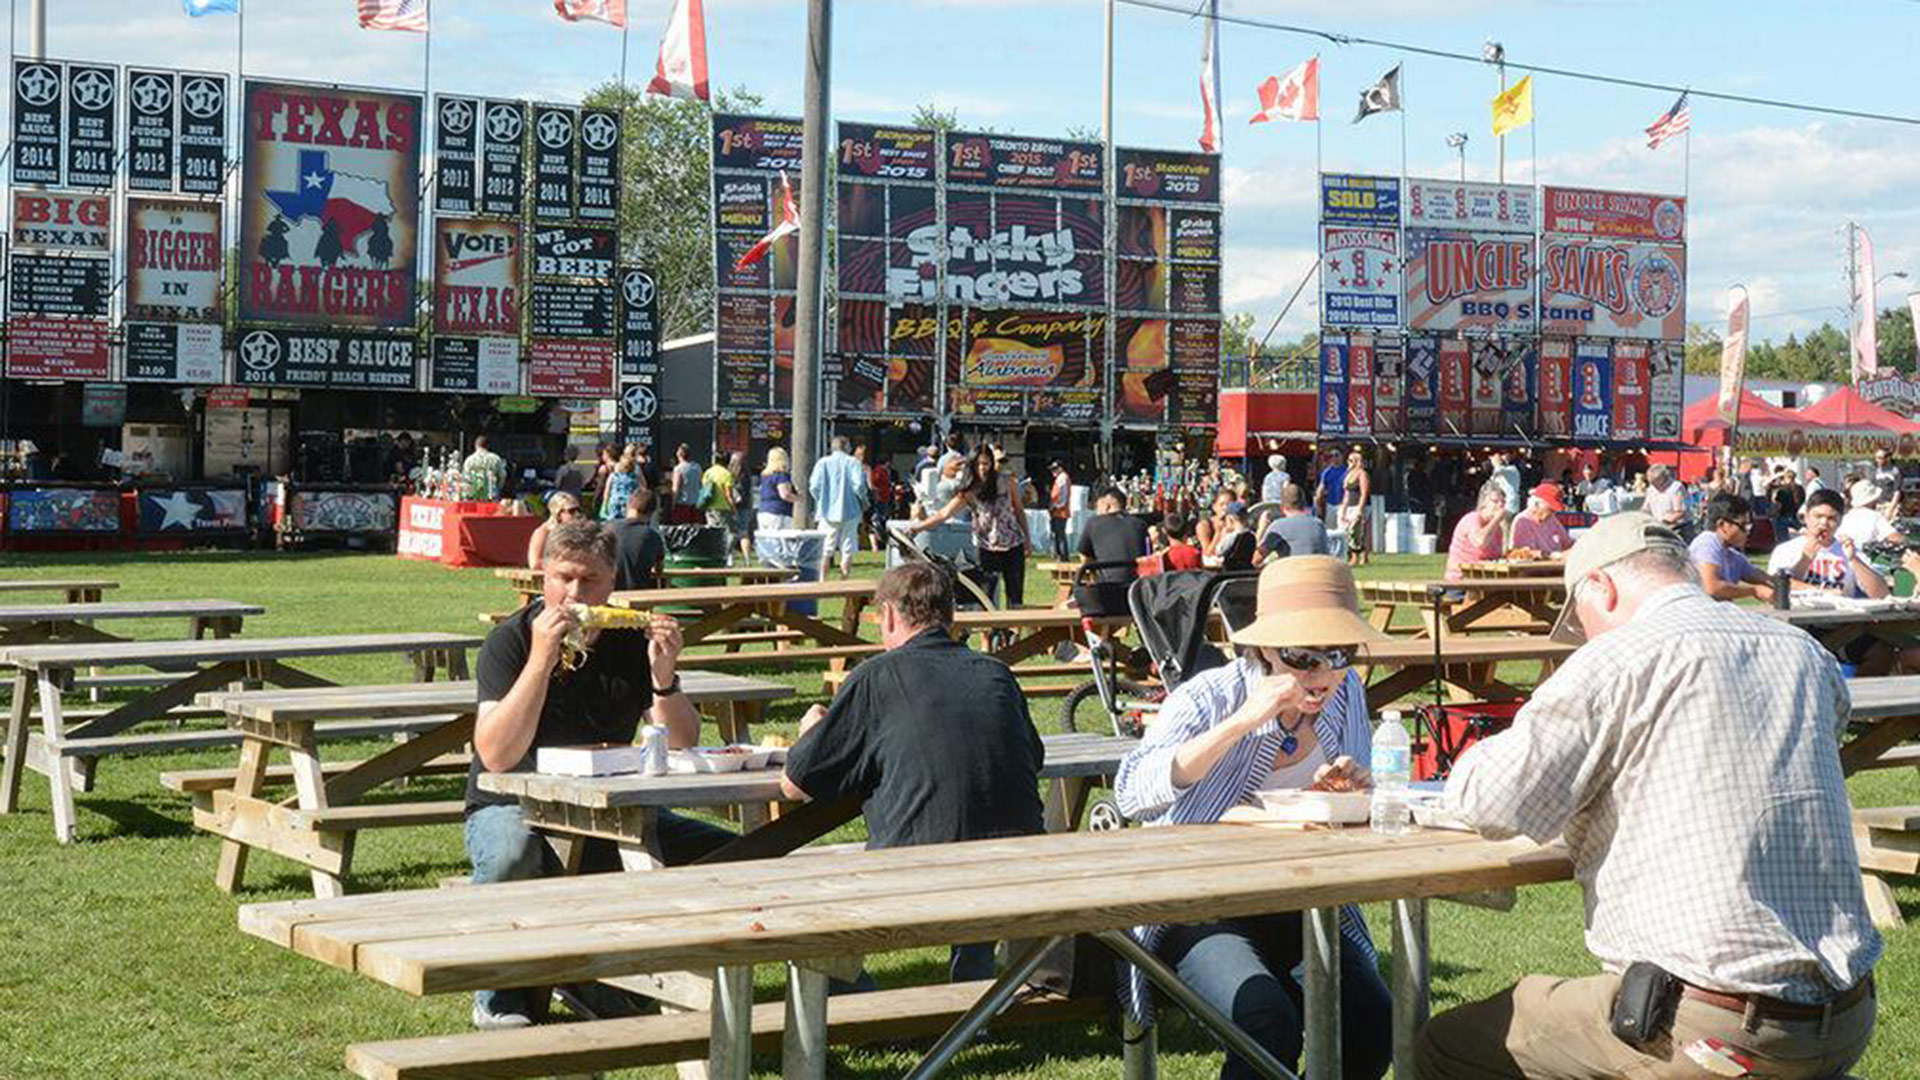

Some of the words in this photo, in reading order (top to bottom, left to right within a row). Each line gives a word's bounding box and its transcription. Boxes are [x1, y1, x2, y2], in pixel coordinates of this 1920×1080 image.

[24, 113, 52, 122] BEST
[78, 117, 105, 128] BEST
[138, 116, 164, 126] BEST
[253, 91, 416, 152] TEXAS
[20, 123, 56, 134] SAUCE
[78, 128, 104, 138] RIBS
[189, 125, 215, 135] BEST
[182, 134, 224, 146] CHICKEN
[444, 136, 467, 147] BEST
[718, 129, 753, 156] 1st
[20, 146, 54, 166] 2014
[543, 154, 566, 164] BEST
[840, 138, 872, 164] 1st
[951, 142, 982, 167] 1st
[989, 140, 1030, 152] TORONTO
[1068, 150, 1098, 174] 1st
[74, 150, 107, 171] 2014
[135, 152, 166, 172] 2012
[186, 158, 218, 178] 2014
[540, 164, 569, 174] SAUCE
[587, 157, 610, 167] BEST
[442, 168, 470, 188] 2011
[876, 165, 928, 178] 2015
[1123, 163, 1152, 188] 1st
[487, 178, 514, 196] 2012
[540, 184, 568, 202] 2014
[584, 186, 610, 206] 2014
[1164, 180, 1200, 194] 2013
[1554, 192, 1604, 212] UNCLE
[17, 196, 110, 228] BIG
[169, 216, 182, 225] IS
[720, 212, 762, 226] MENU
[14, 228, 108, 246] TEXAN
[534, 230, 566, 244] WE
[906, 224, 1074, 266] Sticky
[1326, 231, 1394, 251] MISSISSAUGA
[135, 228, 216, 272] BIGGER
[552, 238, 594, 255] GOT
[1176, 248, 1213, 258] MENU
[536, 256, 613, 278] BEEF
[1428, 239, 1527, 304] UNCLE
[1546, 243, 1629, 315] SAM'S
[161, 282, 188, 296] IN
[250, 261, 406, 319] RANGERS
[888, 268, 1084, 310] Fingers
[442, 286, 516, 325] TEXAS
[1330, 295, 1352, 307] 2013
[1353, 297, 1371, 308] Best
[135, 304, 216, 320] TEXAS
[1328, 310, 1350, 322] 2014
[1351, 312, 1370, 323] Best
[1372, 313, 1396, 324] Sauce
[1461, 302, 1510, 318] BBQ
[1518, 304, 1594, 320] Stand
[891, 319, 964, 340] BBQ
[970, 320, 988, 336] &
[996, 316, 1108, 340] Company
[288, 337, 339, 364] BEST
[348, 340, 412, 366] SAUCE
[244, 370, 276, 383] 2014
[286, 369, 328, 382] FREDDY
[332, 370, 366, 383] BEACH
[369, 372, 410, 385] RIBFEST
[1574, 414, 1609, 435] SAUCE
[1807, 434, 1843, 454] ONION
